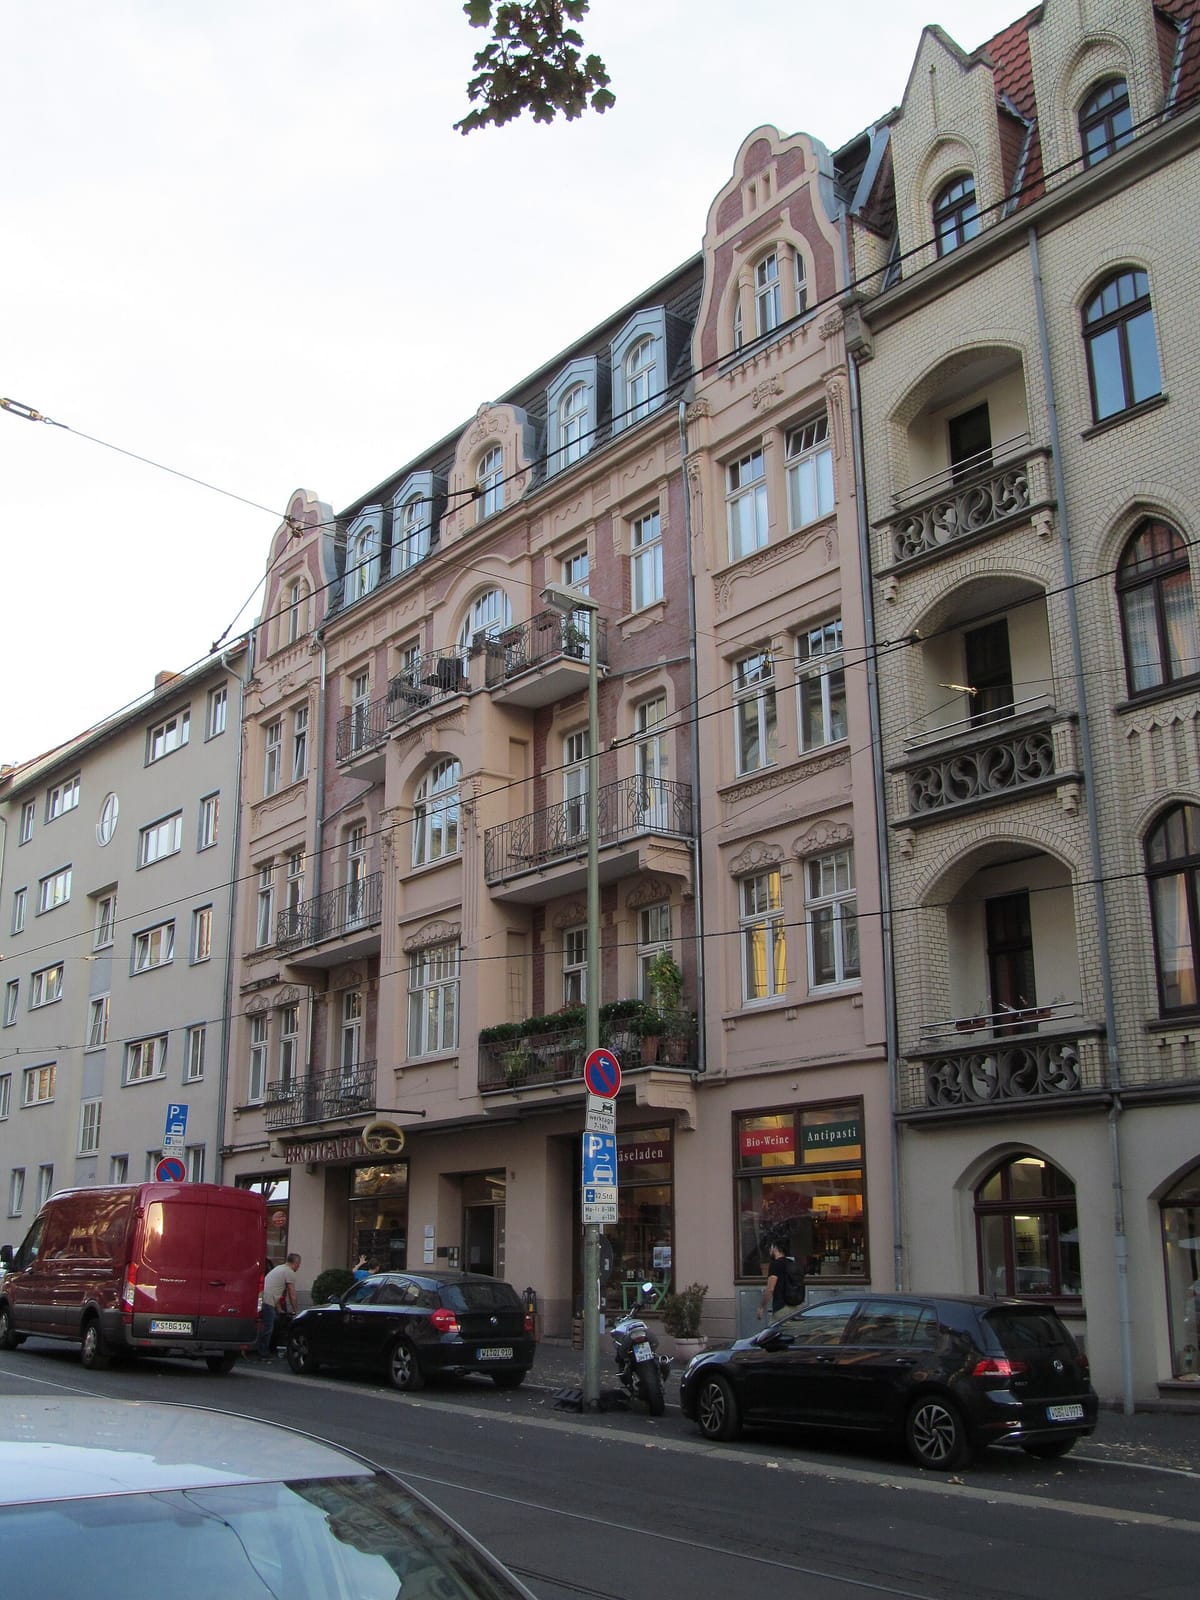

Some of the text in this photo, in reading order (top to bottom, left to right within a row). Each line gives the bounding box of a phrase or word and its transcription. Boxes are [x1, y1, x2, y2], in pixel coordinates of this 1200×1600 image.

[746, 1135, 790, 1148] Bio-Weine
[807, 1127, 857, 1143] Antipasti
[589, 1136, 603, 1158] P
[618, 1147, 664, 1162] äseladen
